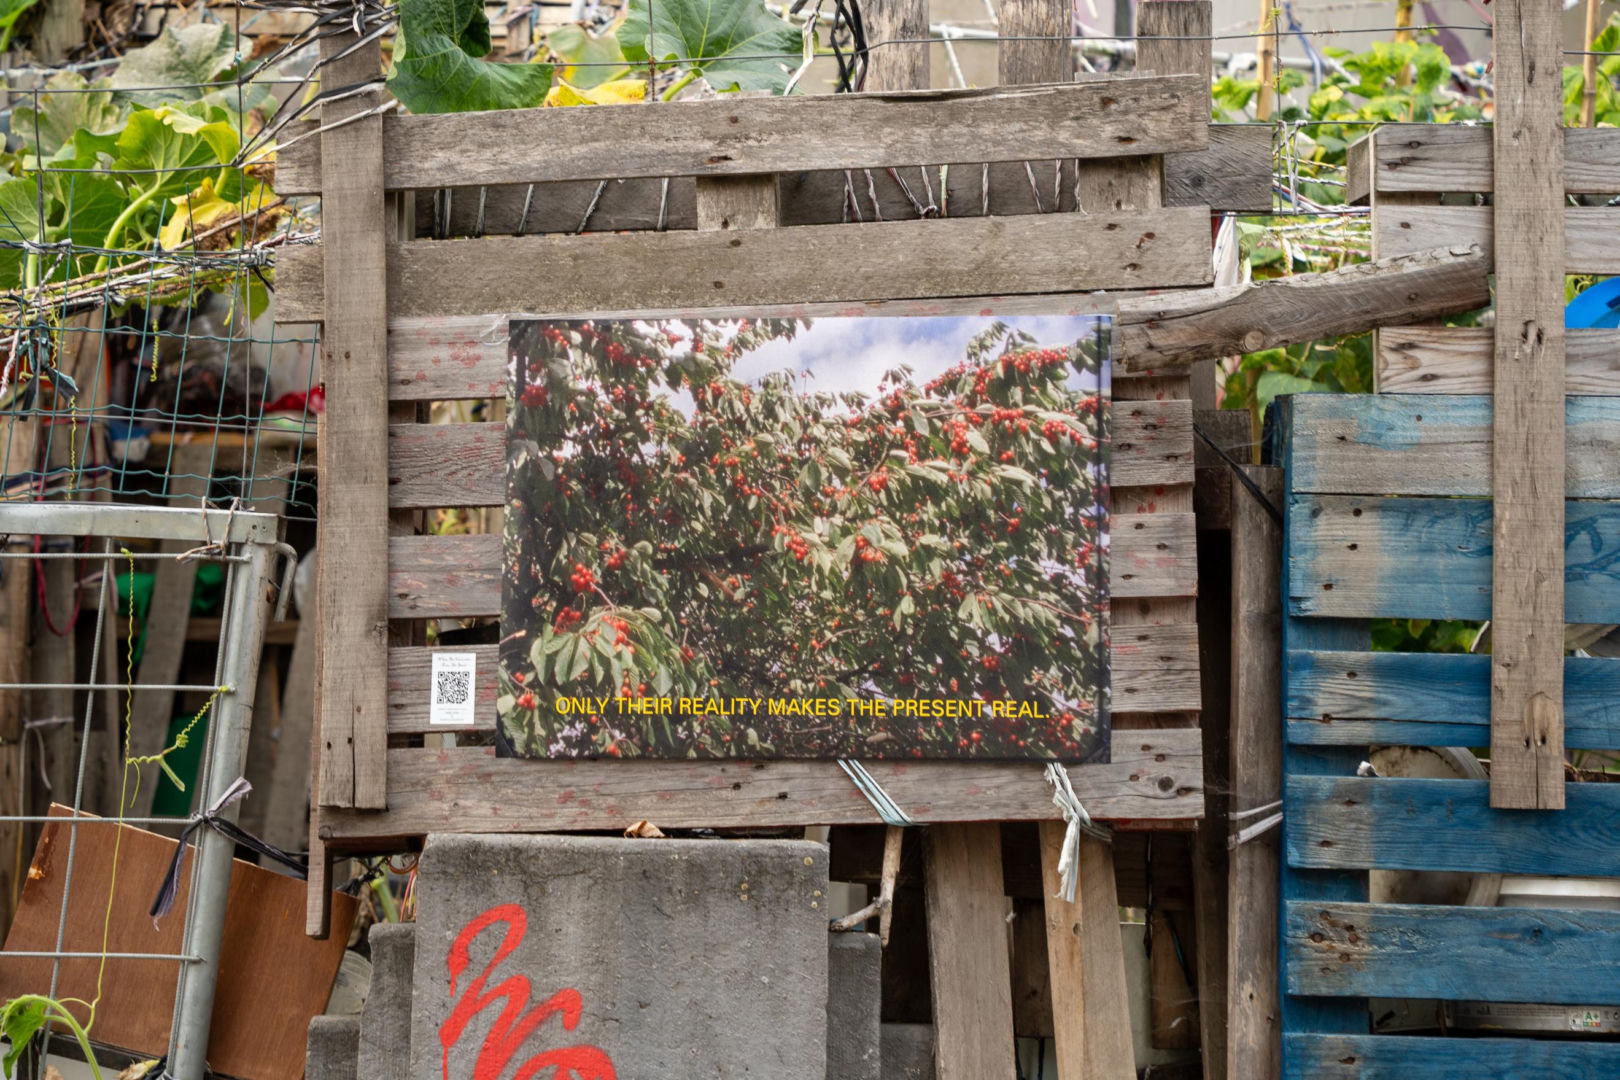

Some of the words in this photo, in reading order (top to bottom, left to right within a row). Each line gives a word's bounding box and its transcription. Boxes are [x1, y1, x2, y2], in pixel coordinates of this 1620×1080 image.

[555, 696, 609, 715] ONLY
[615, 697, 673, 715] THEIR
[679, 697, 762, 716] REALITY
[768, 698, 841, 716] MAKES
[847, 698, 886, 717] THE
[893, 698, 984, 718] PRESENT
[992, 700, 1050, 719] REAL.
